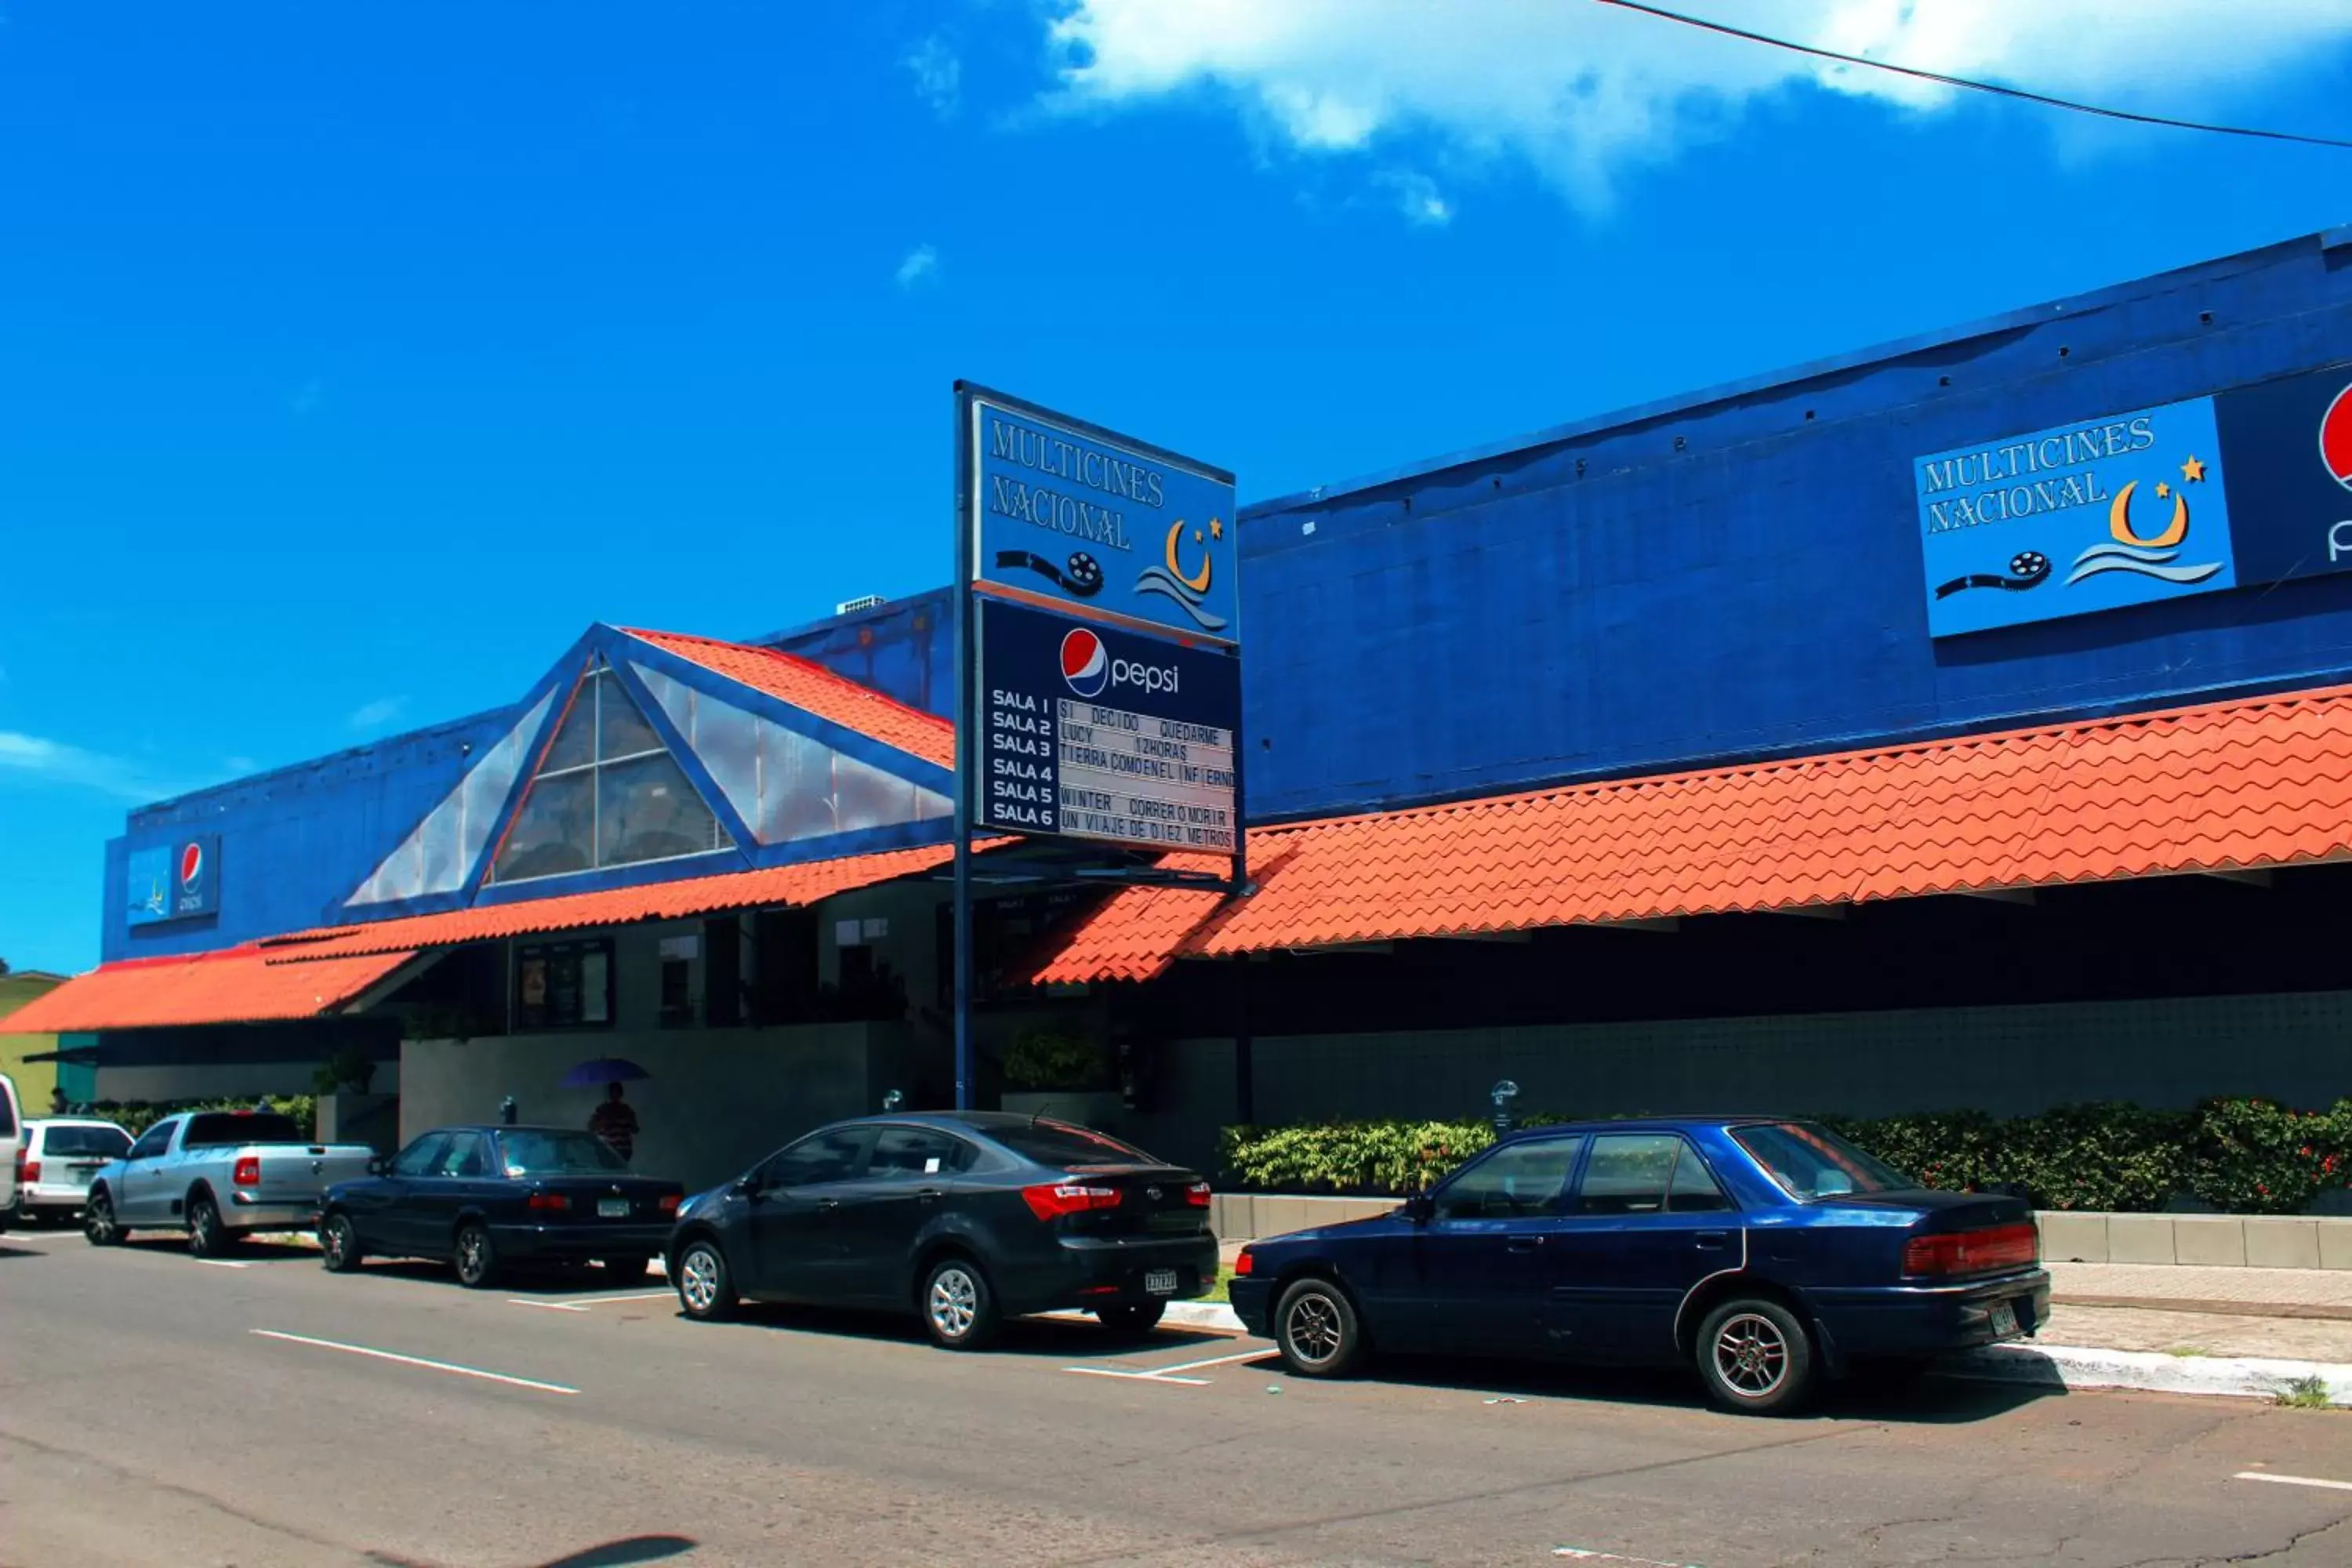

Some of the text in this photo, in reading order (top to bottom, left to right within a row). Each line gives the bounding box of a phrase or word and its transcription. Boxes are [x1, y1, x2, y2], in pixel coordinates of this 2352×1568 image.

[992, 419, 1164, 509] MULTICINES
[1923, 416, 2156, 494] MULTICINES
[992, 476, 1131, 551] NACIONAL
[1925, 472, 2108, 535] NACIONAL
[1112, 659, 1178, 694] pepsi
[993, 689, 1049, 714] SALA 1
[993, 711, 1051, 736] SALA 2
[1060, 701, 1220, 746] SI DECIDO QUEDARME
[1062, 722, 1092, 743] LUCY
[993, 733, 1051, 757] SALA 3
[1060, 743, 1108, 768] TIERRA
[993, 758, 1053, 782] SALA 4
[993, 780, 1053, 804] SALA 5
[1061, 786, 1111, 811] WINTER
[1130, 798, 1175, 820] CORRER
[993, 803, 1053, 826] SALA 6
[1062, 810, 1232, 848] UN VIAJE DE DIEZ METROS
